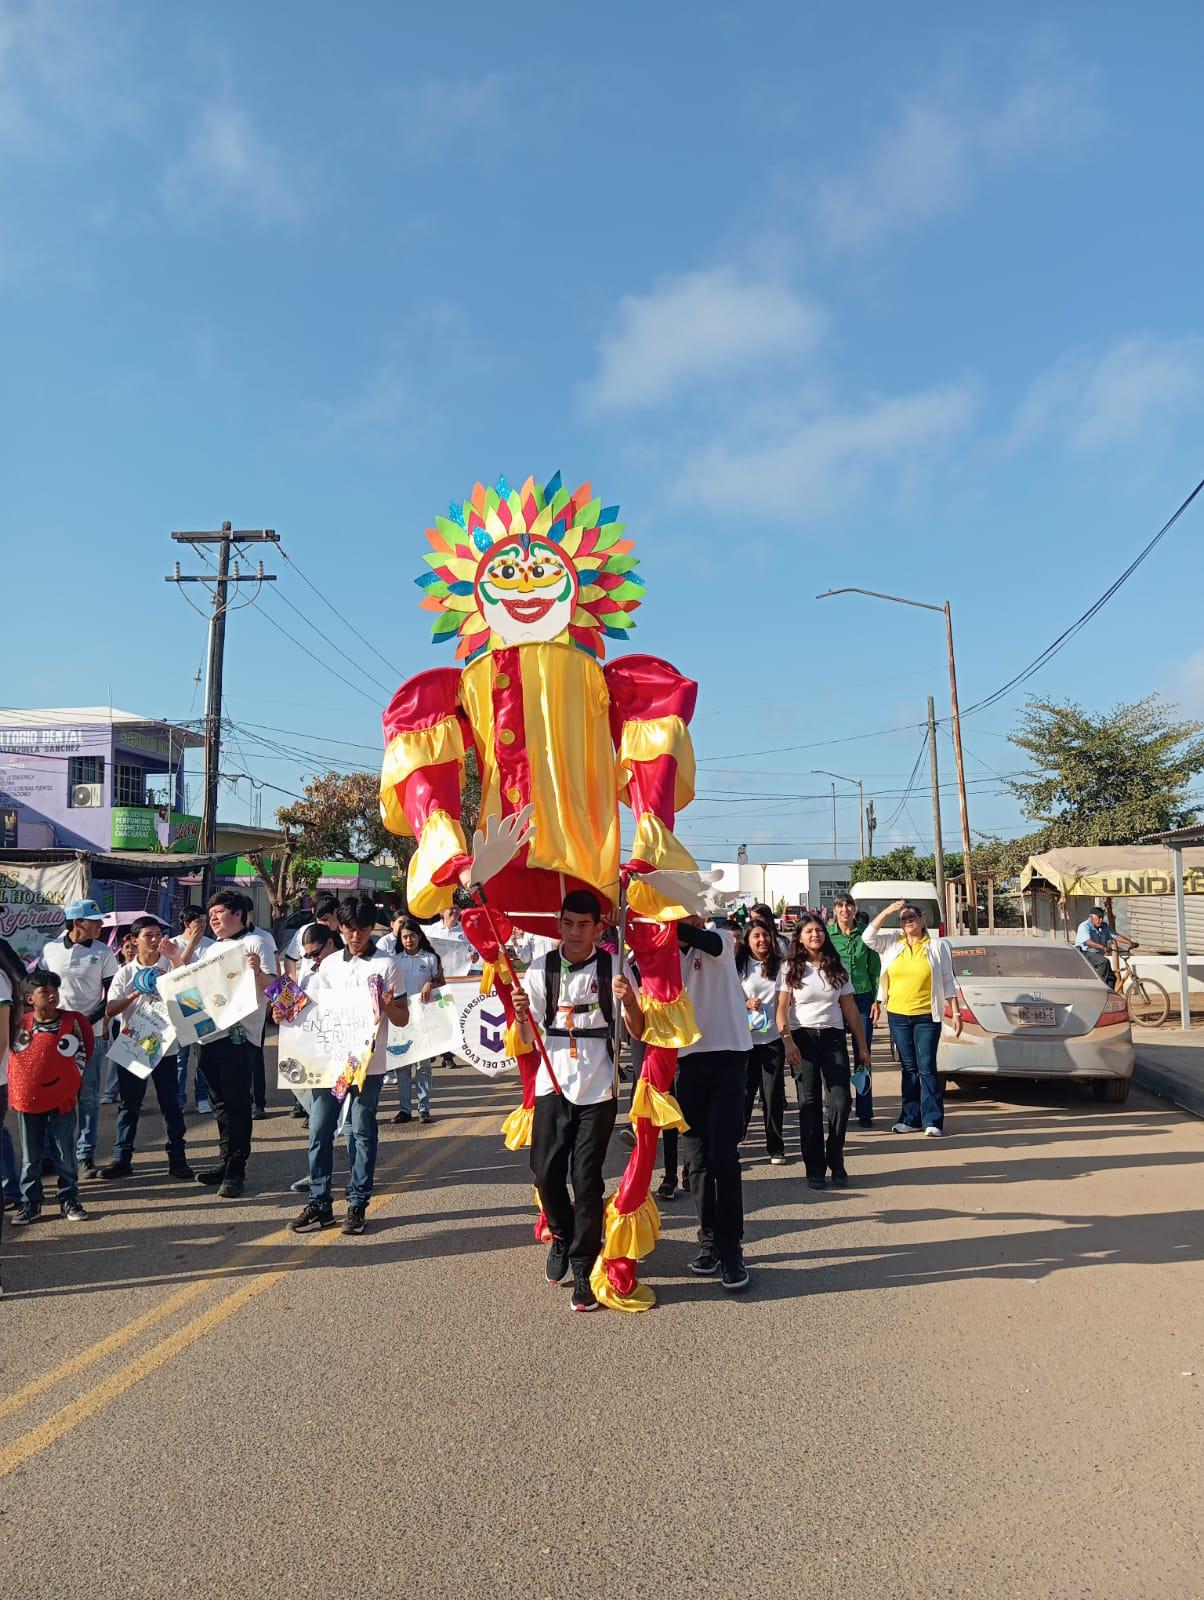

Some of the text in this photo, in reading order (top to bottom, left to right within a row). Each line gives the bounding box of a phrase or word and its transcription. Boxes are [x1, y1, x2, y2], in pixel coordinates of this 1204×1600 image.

[43, 730, 83, 743] DENTAL
[11, 889, 65, 905] HOGAR
[461, 1037, 481, 1064] ÉVOR
[482, 1059, 498, 1069] DEL
